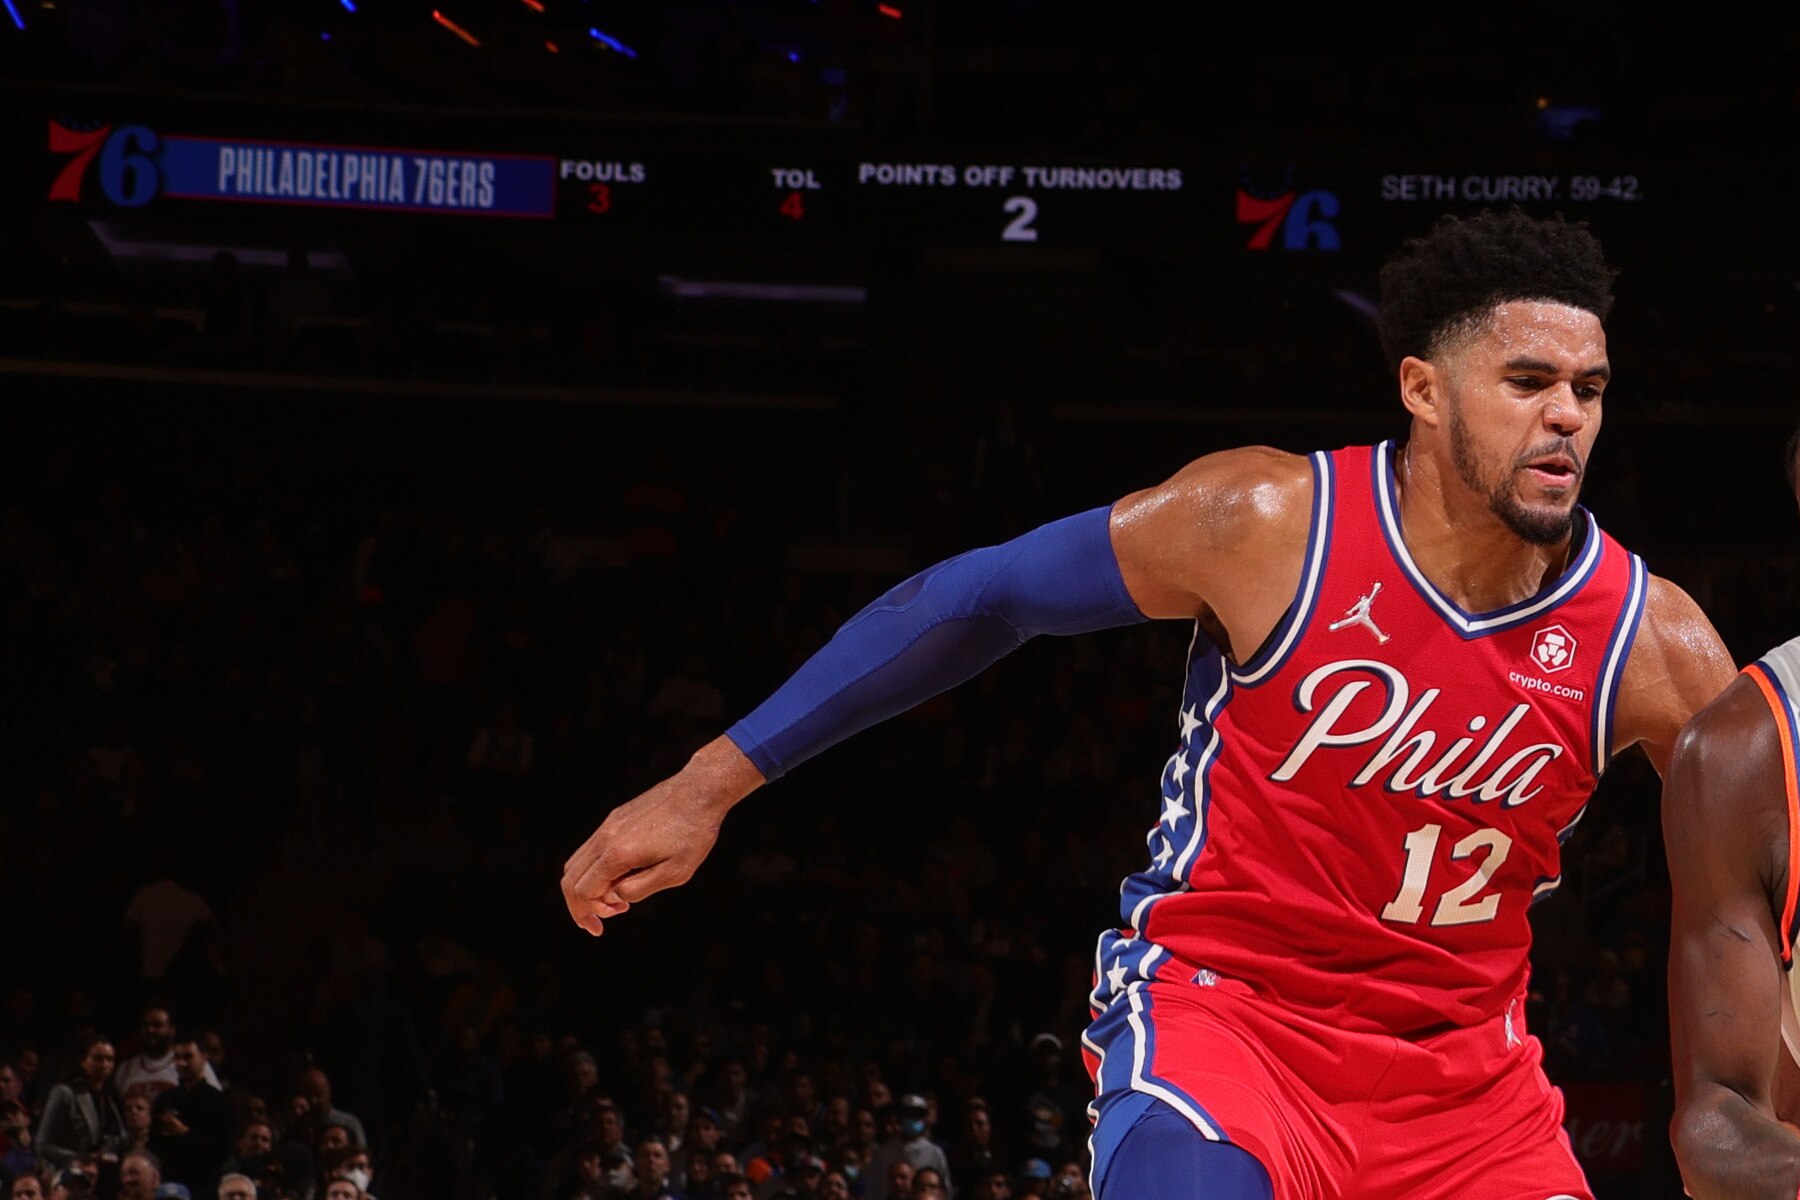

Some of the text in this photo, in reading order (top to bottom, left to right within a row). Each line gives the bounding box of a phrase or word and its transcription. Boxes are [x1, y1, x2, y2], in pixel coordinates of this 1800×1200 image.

[47, 117, 160, 207] 76
[218, 146, 496, 208] PHILADELPHIA 76ERS
[559, 160, 647, 183] FOULS
[771, 168, 822, 189] TOL
[858, 162, 1184, 191] POINTS OFF TURNOVERS
[585, 182, 613, 215] 3
[1380, 174, 1456, 201] SETH
[777, 190, 807, 221] 4
[1002, 196, 1038, 241] 2
[1234, 186, 1342, 252] 76
[1509, 671, 1584, 701] crypto.com
[1268, 659, 1564, 809] Phila
[1380, 823, 1513, 927] 12
